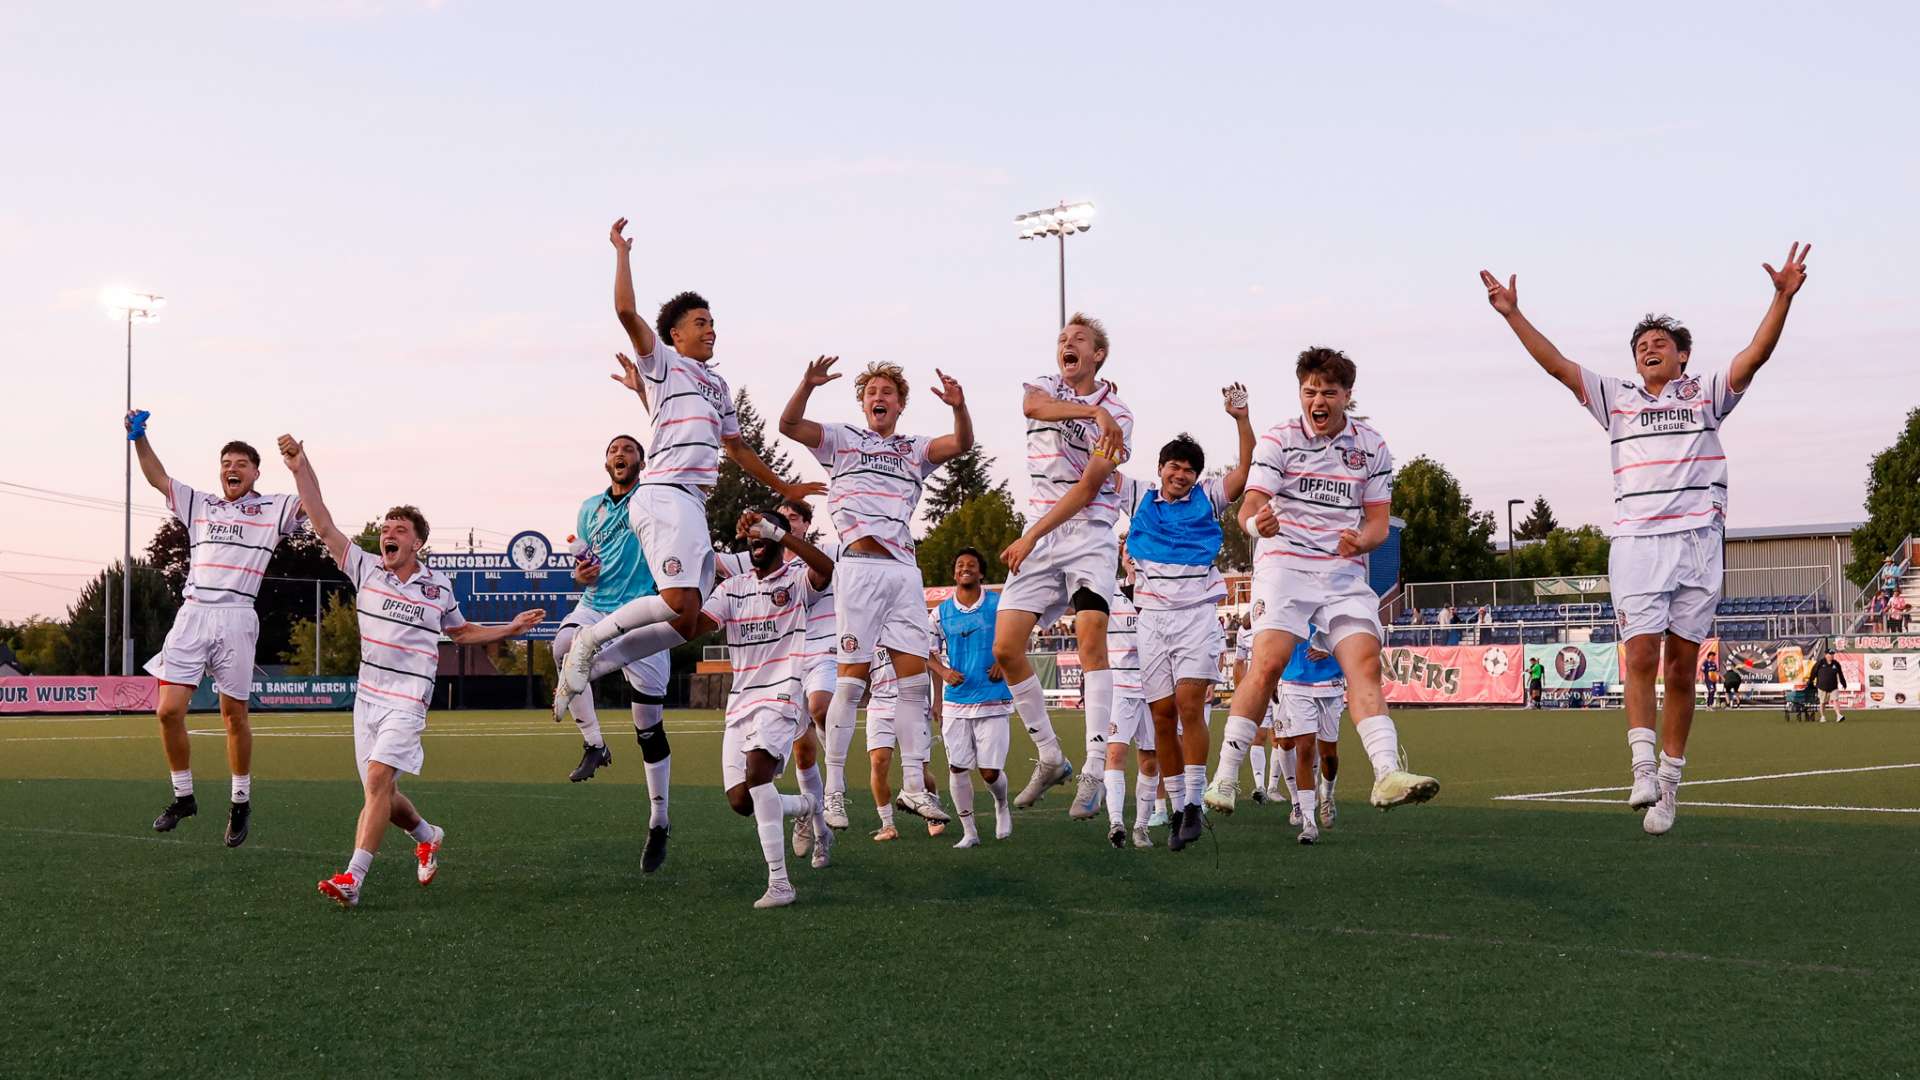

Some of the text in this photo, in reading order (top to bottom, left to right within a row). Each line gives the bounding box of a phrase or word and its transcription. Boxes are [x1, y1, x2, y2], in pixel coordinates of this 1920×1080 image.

[1641, 408, 1696, 427] OFFICIAL
[1653, 422, 1685, 431] LEAGUE
[861, 452, 904, 472] OFFICIAL
[871, 463, 896, 472] LEAGUE
[1300, 477, 1353, 500] OFFICIAL
[1310, 492, 1341, 504] LEAGUE
[428, 555, 512, 568] CONCORDIA
[484, 571, 502, 579] BALL
[524, 571, 549, 579] STRIKE
[382, 598, 425, 621] OFFICIAL
[389, 610, 416, 623] LEAGUE
[740, 620, 779, 637] OFFICIAL
[36, 686, 98, 702] WURST
[266, 682, 308, 693] BANGIN'
[312, 682, 346, 693] MERCH
